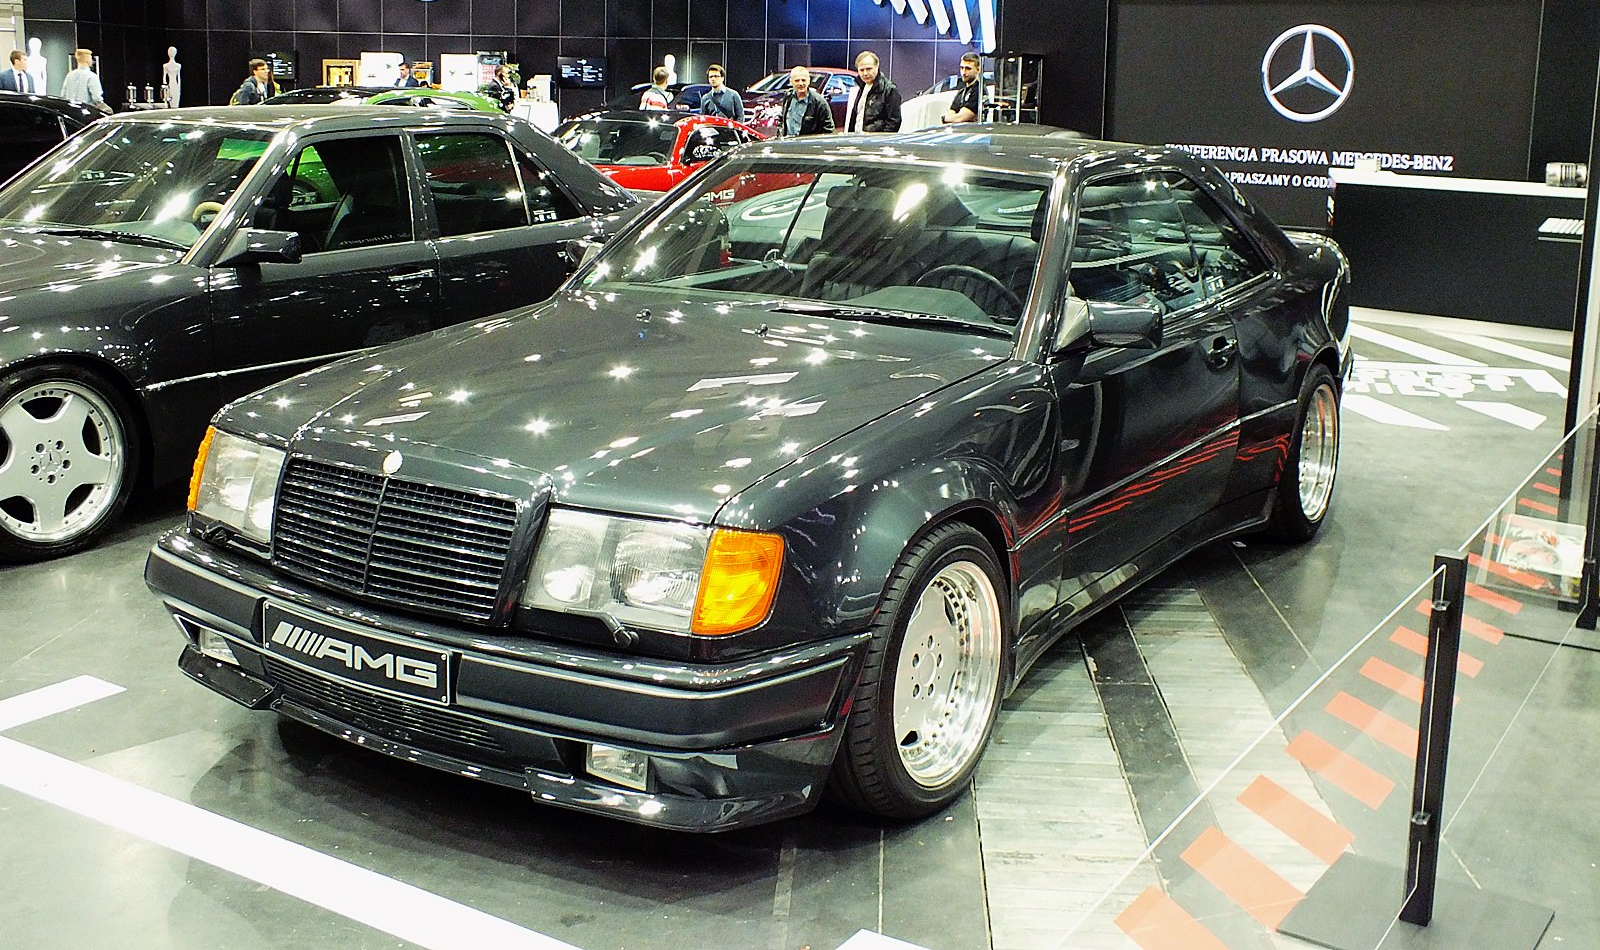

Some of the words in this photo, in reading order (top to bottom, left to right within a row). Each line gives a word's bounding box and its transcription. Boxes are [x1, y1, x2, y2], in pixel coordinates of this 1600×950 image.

[1261, 147, 1328, 165] PRASOWA
[1292, 175, 1302, 187] O
[316, 636, 438, 689] AMG
